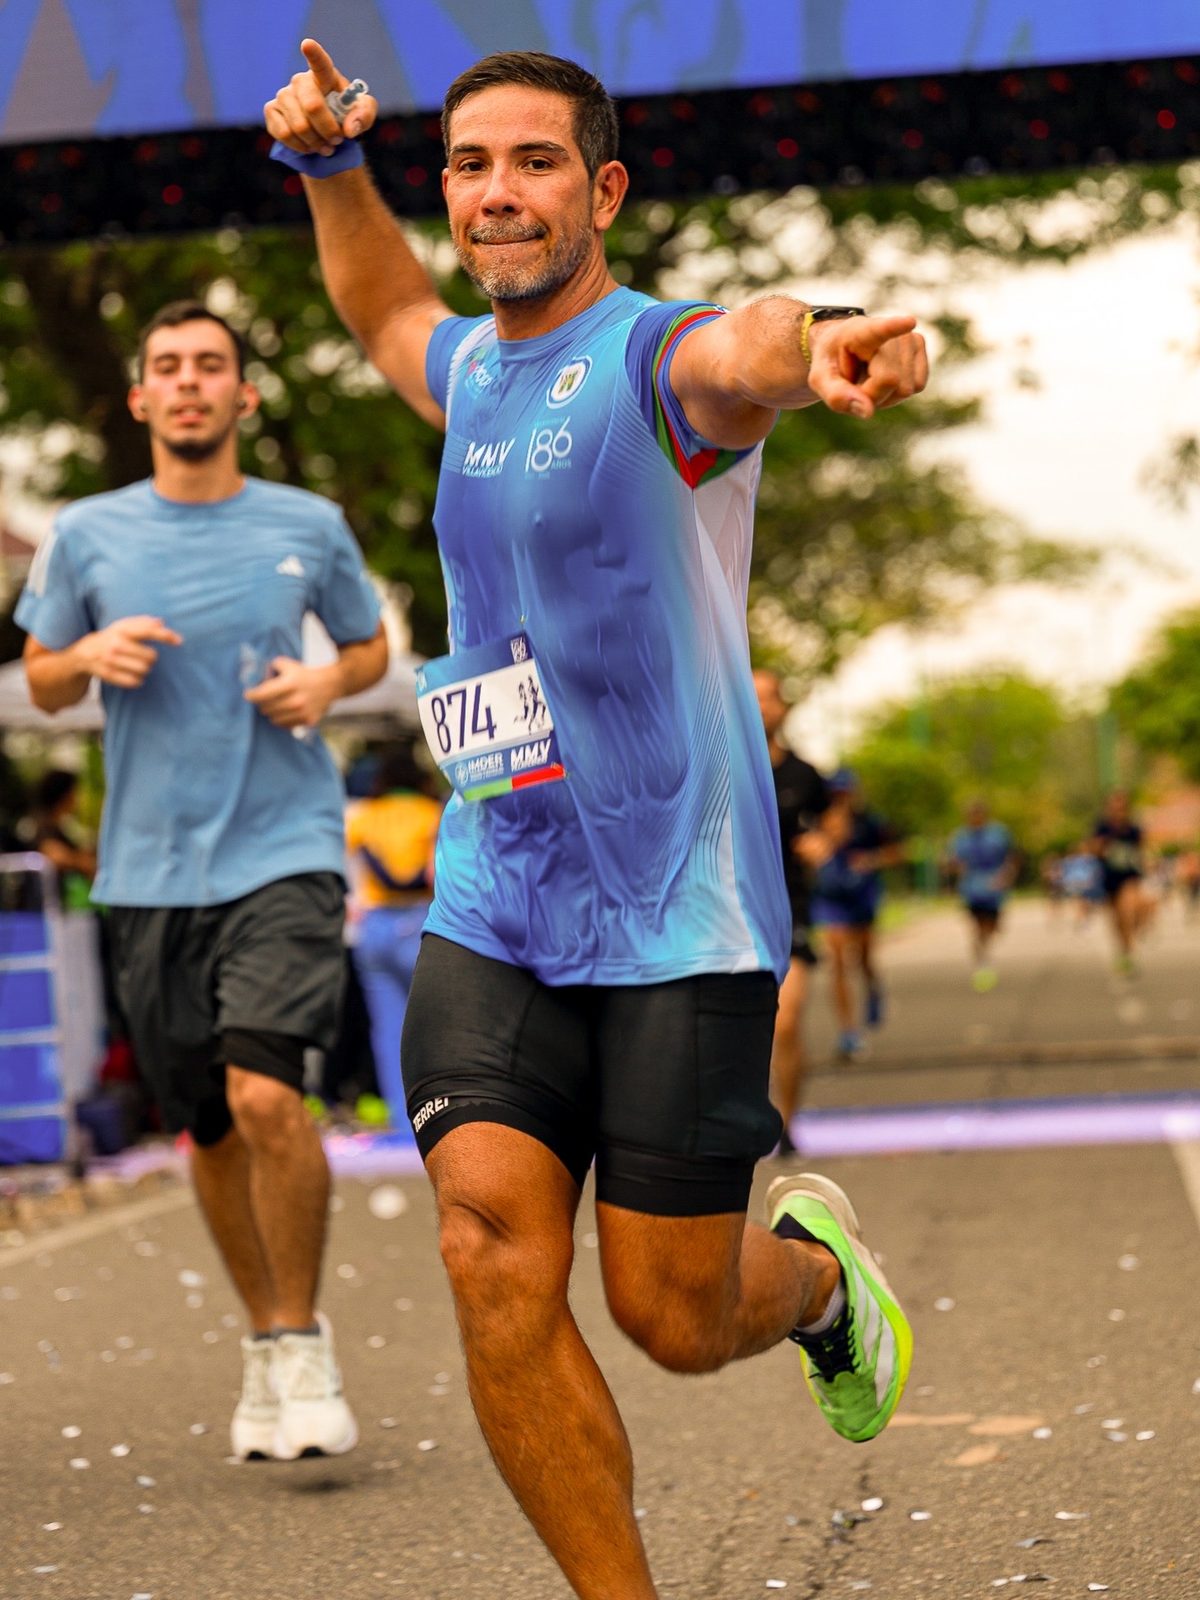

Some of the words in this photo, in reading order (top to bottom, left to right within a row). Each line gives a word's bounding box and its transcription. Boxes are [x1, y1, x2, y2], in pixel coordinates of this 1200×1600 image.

[463, 437, 516, 467] MMV
[525, 415, 573, 472] 186
[431, 683, 497, 754] 874
